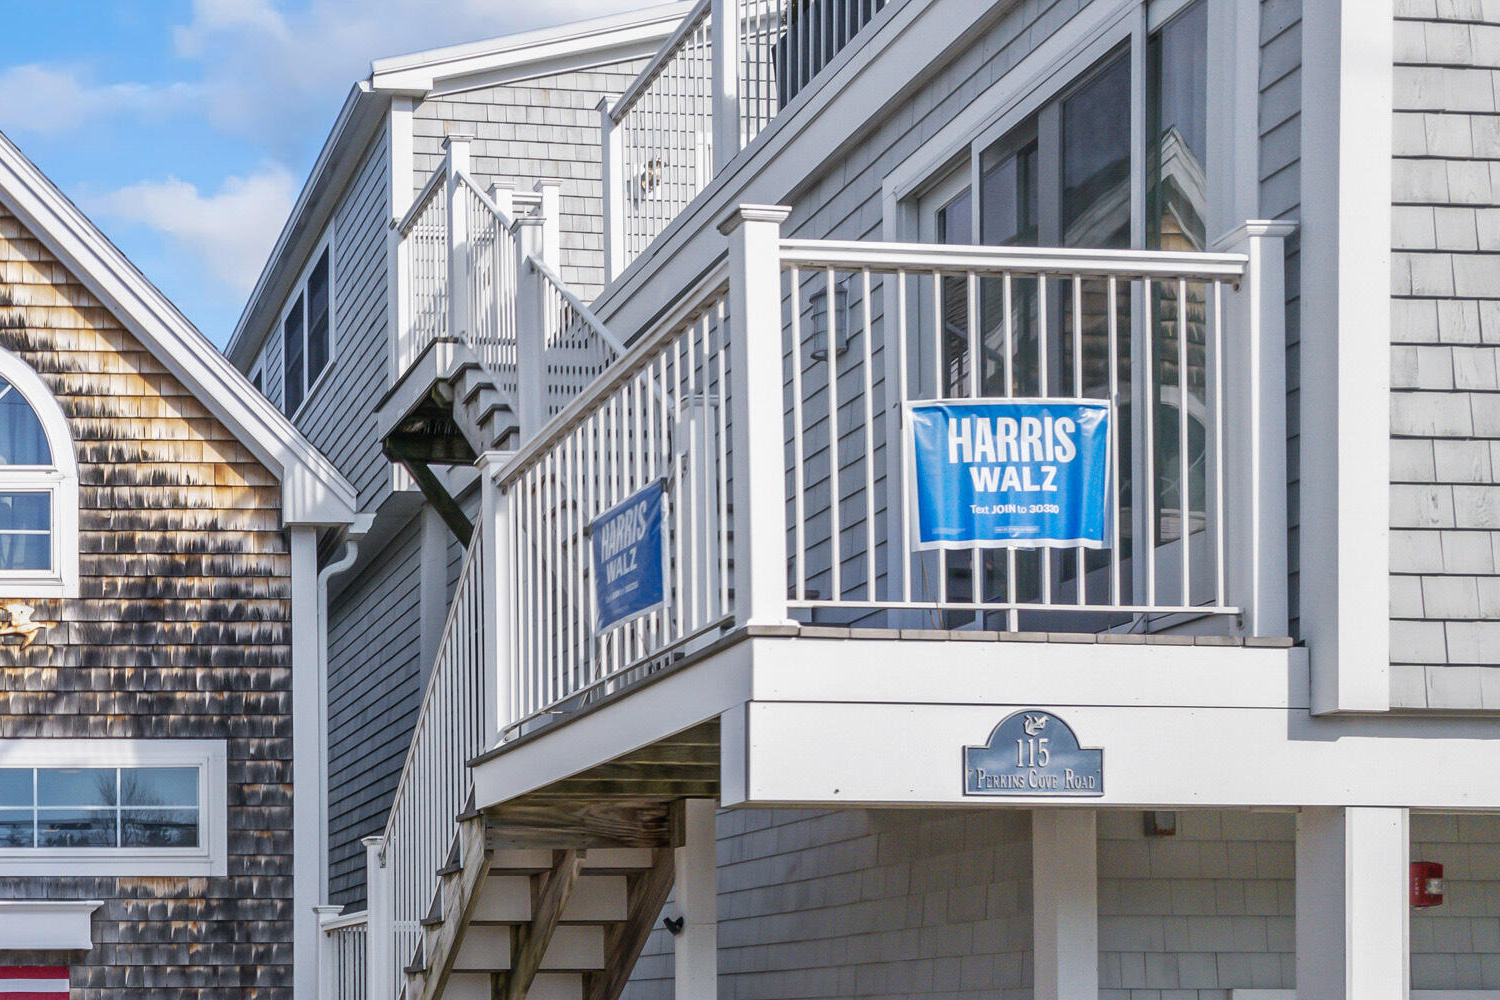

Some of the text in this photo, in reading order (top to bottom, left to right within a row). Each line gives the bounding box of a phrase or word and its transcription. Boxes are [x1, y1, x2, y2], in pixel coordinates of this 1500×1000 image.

[948, 416, 1077, 463] HARRIS
[969, 466, 1058, 492] WALZ
[969, 504, 989, 514] Text
[991, 504, 1016, 514] JOIN
[1017, 505, 1027, 514] to
[600, 500, 647, 563] HARRIS
[606, 547, 637, 584] WALZ
[1016, 738, 1050, 768] 115
[976, 768, 1025, 789] PERKINS
[1064, 768, 1095, 790] ROAD
